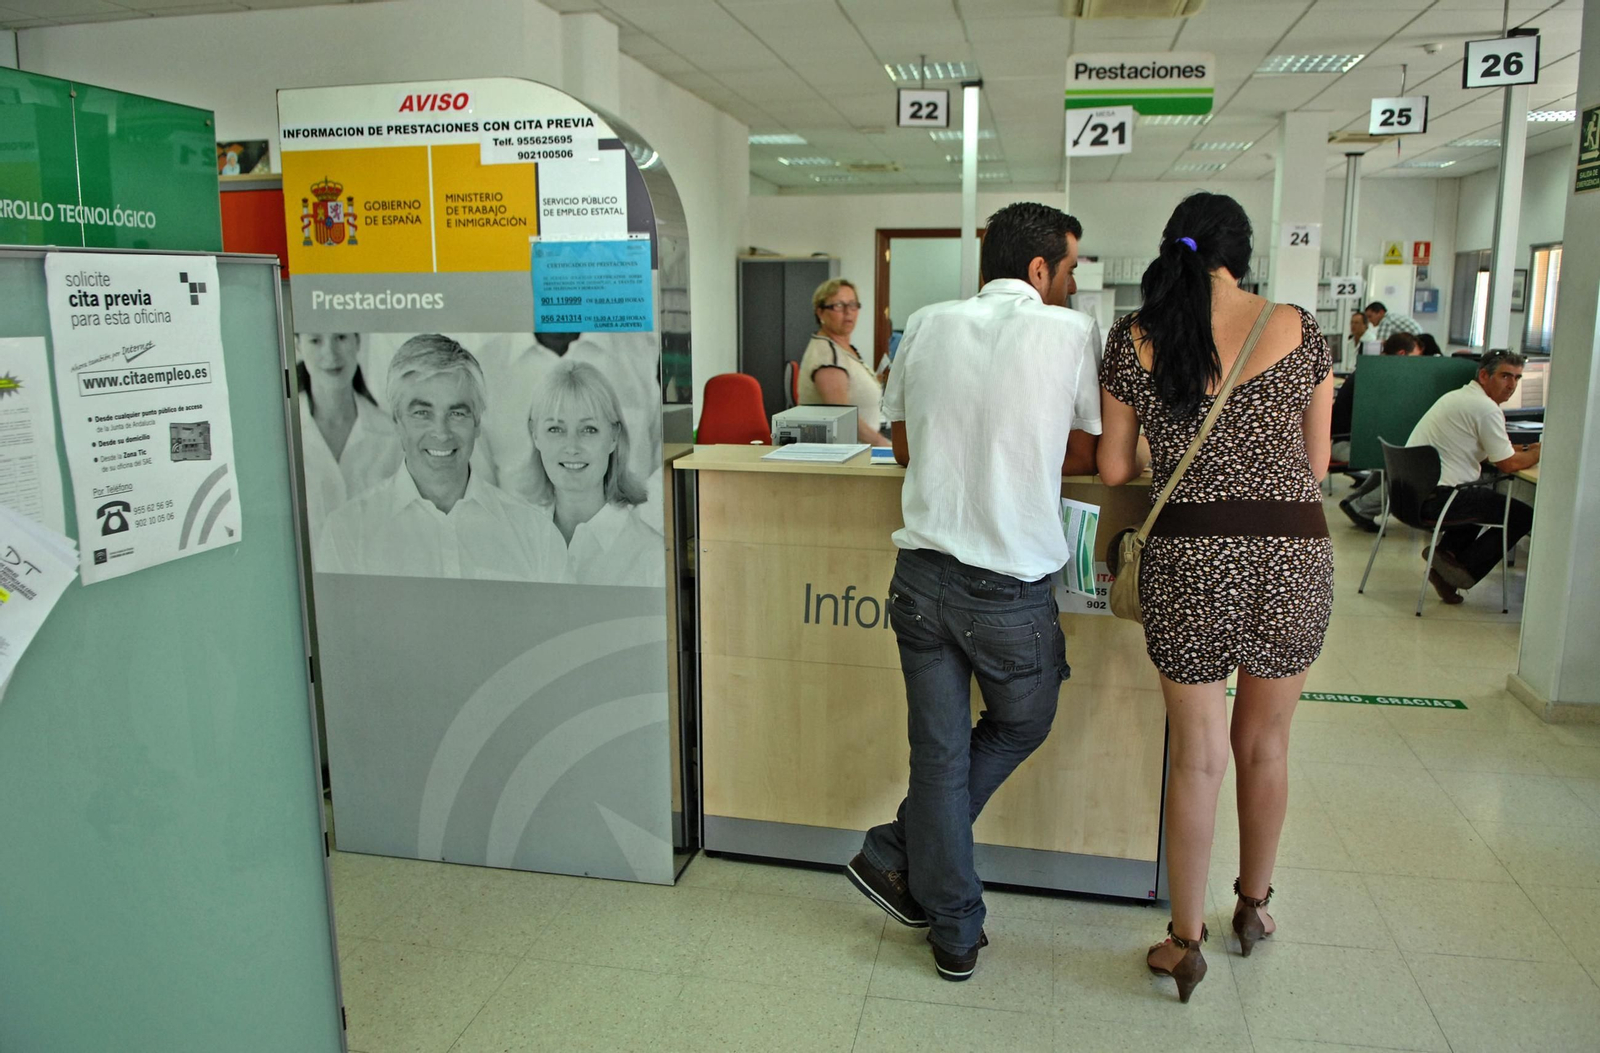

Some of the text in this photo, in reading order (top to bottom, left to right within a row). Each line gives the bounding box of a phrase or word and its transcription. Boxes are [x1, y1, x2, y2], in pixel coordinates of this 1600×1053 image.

[1074, 62, 1206, 80] Prestaciones
[1480, 52, 1523, 78] 26
[398, 92, 469, 113] AVISO
[909, 101, 938, 119] 22
[1379, 107, 1412, 126] 25
[282, 117, 594, 139] INFORMACION DE PRESTACIONES CON CITA PREVIA
[1090, 121, 1126, 146] 21
[493, 135, 573, 146] Telf. 955625695
[517, 149, 573, 160] 902100506
[445, 192, 503, 203] MINISTERIO
[543, 195, 618, 206] SERVICIO PÚBLICO
[364, 199, 422, 212] GOBIERNO
[446, 204, 507, 217] DE TRABAJO
[543, 207, 624, 217] DE EMPLEO ESTATAL
[57, 203, 156, 229] TECNOLÓGICO
[364, 213, 422, 226] DE ESPAÑA
[447, 215, 527, 228] E INMIGRACIÓN
[1290, 232, 1310, 246] 24
[65, 271, 110, 287] solicite
[1337, 283, 1356, 295] 23
[69, 289, 152, 310] cita previa
[312, 289, 444, 310] Prestaciones
[71, 308, 172, 330] para esta oficina
[83, 367, 208, 390] www.citaempleo.es
[95, 414, 113, 423] Desde
[98, 439, 116, 447] Desde
[133, 505, 146, 516] 955
[146, 503, 155, 513] 62
[165, 499, 174, 508] 95
[134, 518, 147, 528] 902
[1086, 600, 1107, 610] 902
[1376, 696, 1456, 708] GRACIAS
